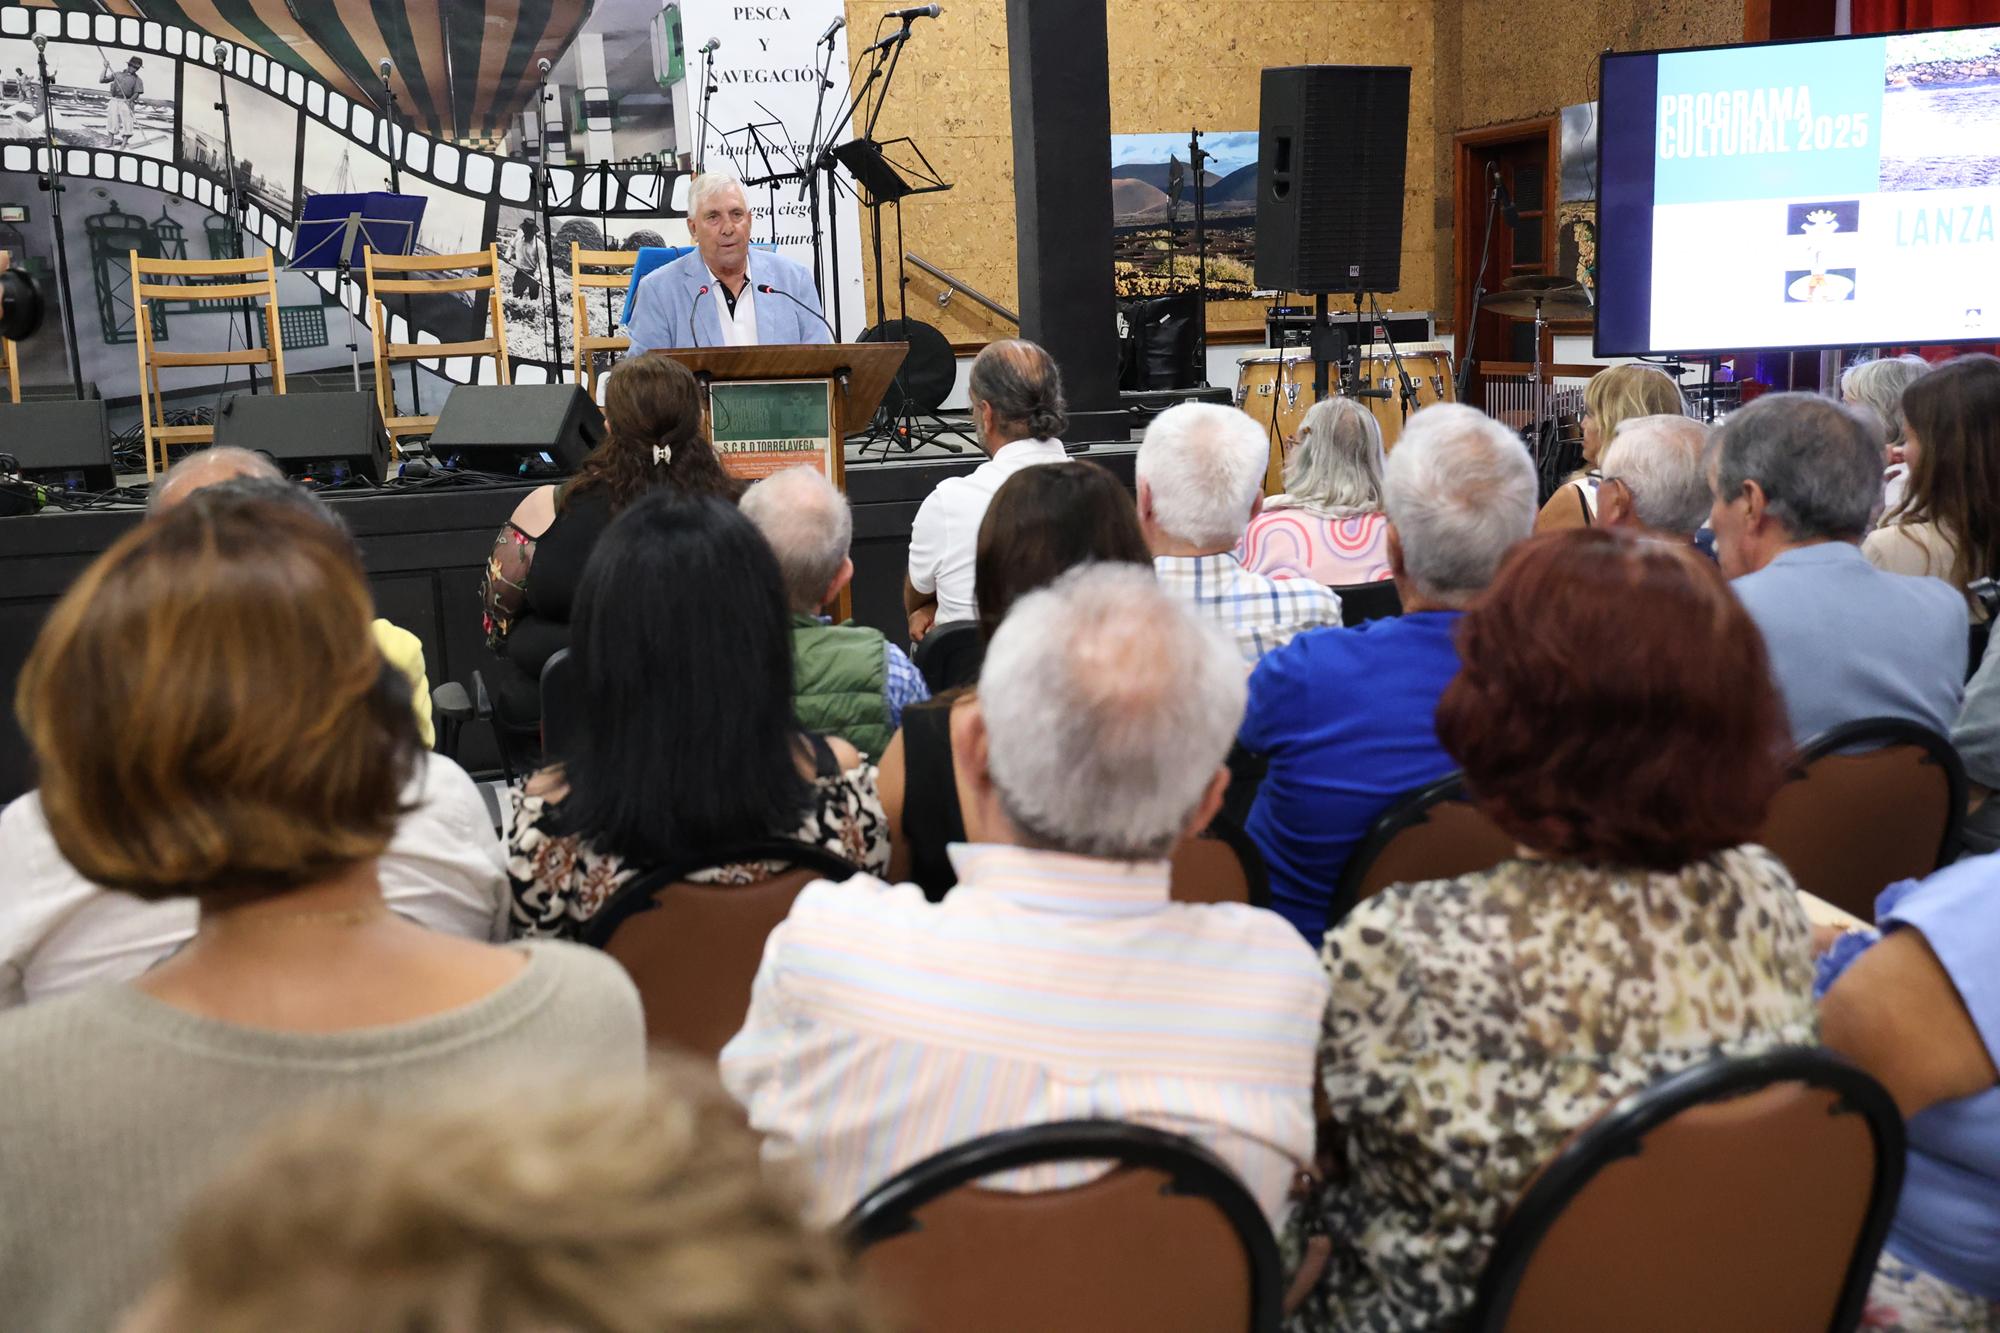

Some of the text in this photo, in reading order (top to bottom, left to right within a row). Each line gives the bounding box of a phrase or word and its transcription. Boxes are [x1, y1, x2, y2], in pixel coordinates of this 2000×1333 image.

[733, 6, 791, 21] PESCA
[758, 38, 770, 52] Y
[1660, 85, 1812, 128] PROGRAMA
[1659, 113, 1869, 159] CULTURAL 2025
[756, 440, 815, 453] TORRELAVEGA
